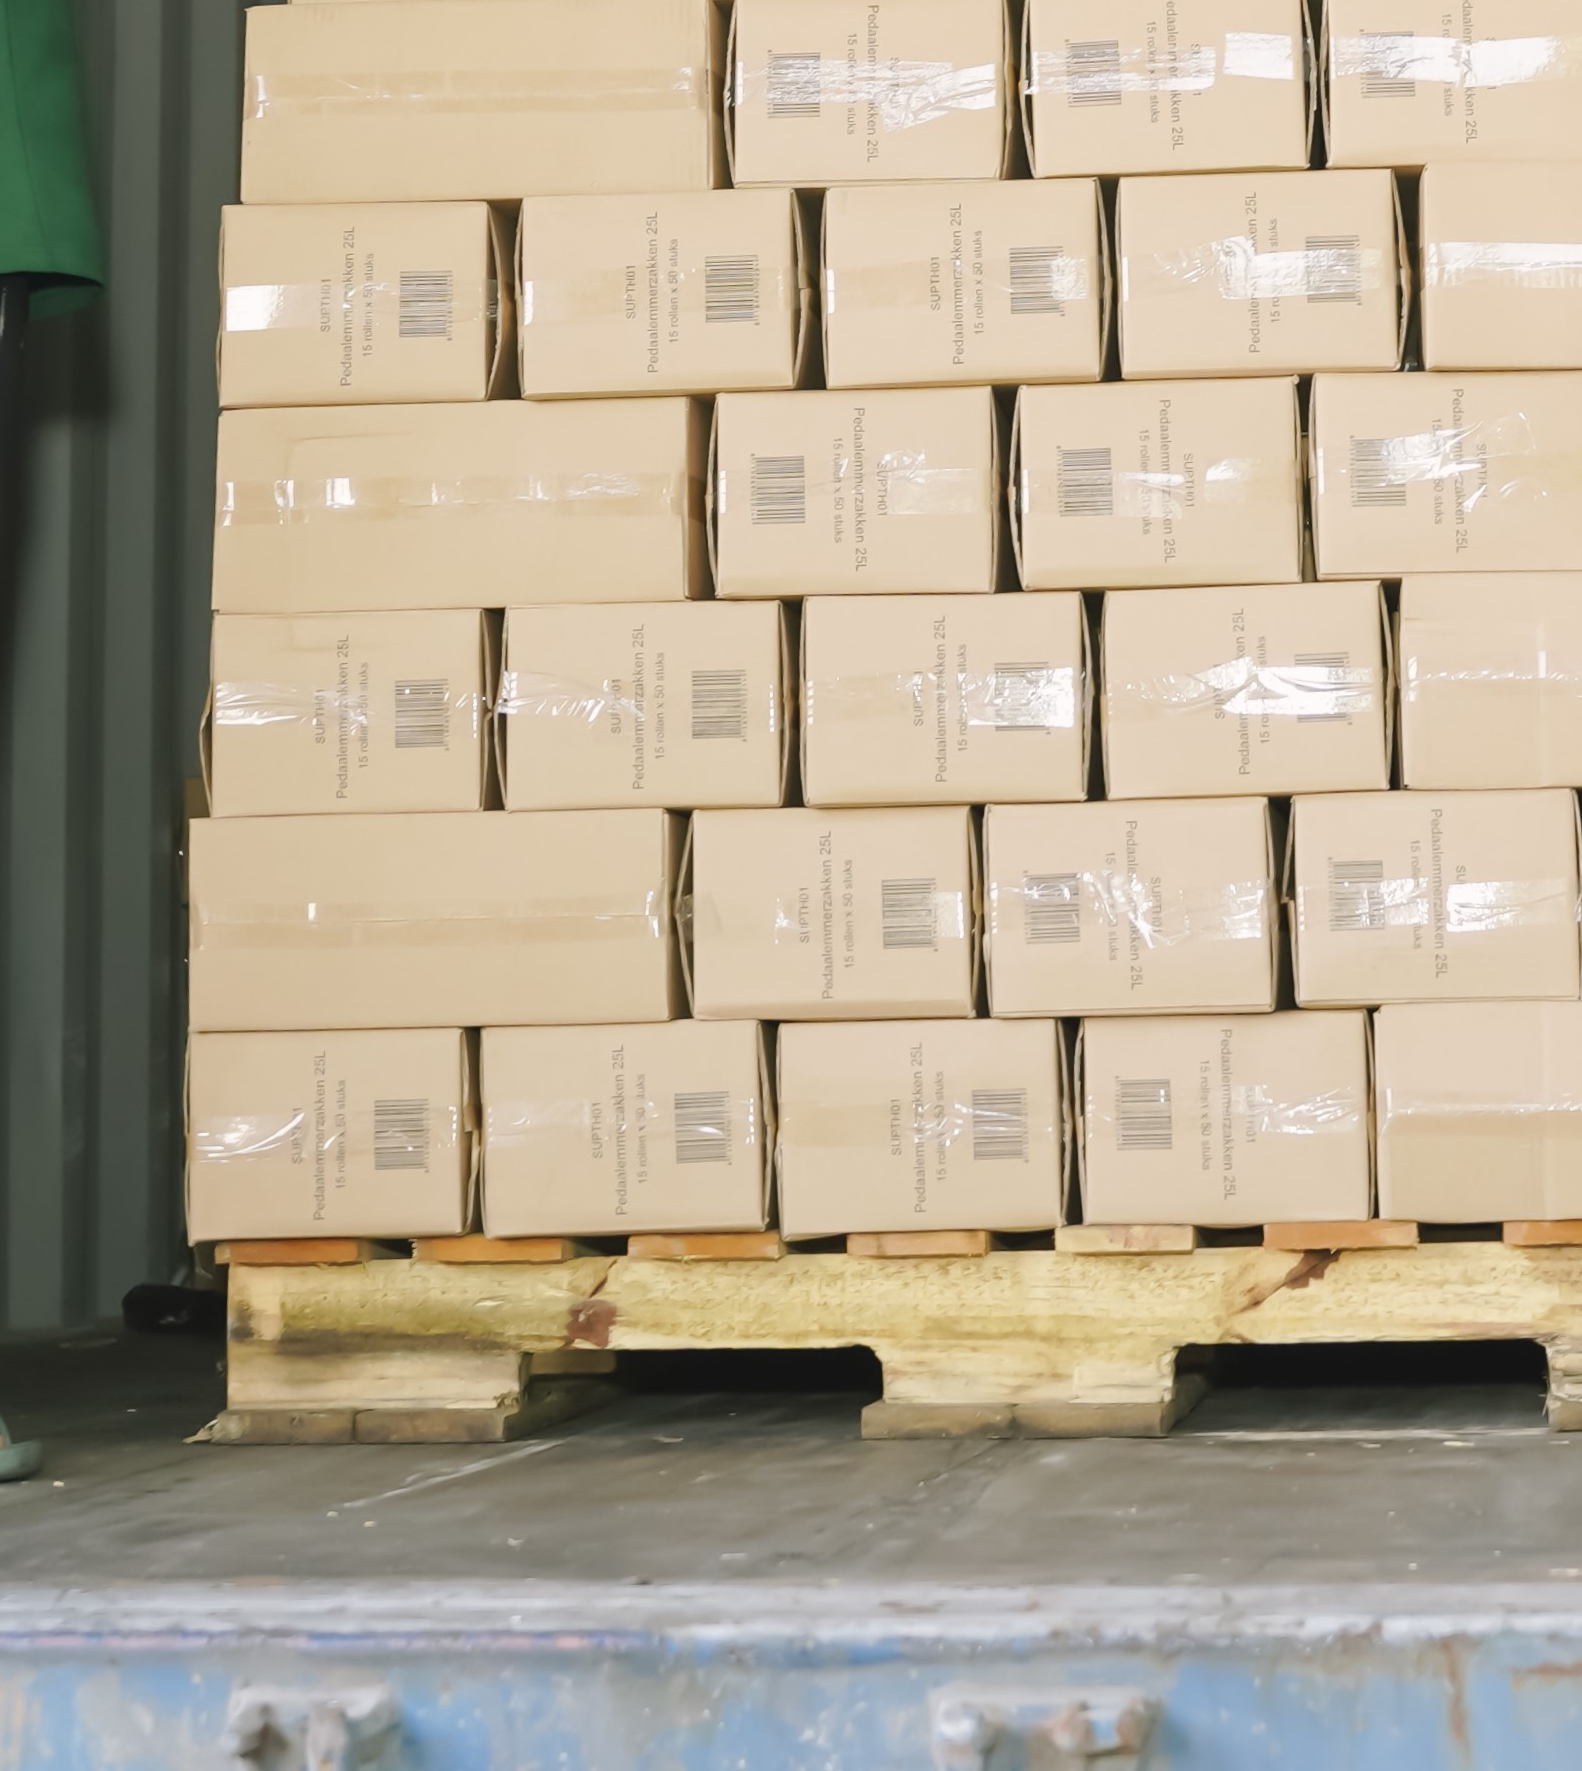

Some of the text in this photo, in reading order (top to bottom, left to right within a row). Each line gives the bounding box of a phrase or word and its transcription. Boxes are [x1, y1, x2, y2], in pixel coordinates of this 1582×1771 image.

[847, 33, 857, 136] 15 stuks
[1147, 21, 1160, 124] 15 stuks
[1442, 13, 1454, 117] 15 stuks
[866, 139, 878, 164] 25L
[1171, 127, 1183, 152] 25L
[1465, 120, 1477, 145] 25L
[950, 202, 962, 227] 25L
[1245, 190, 1257, 215] 25L
[342, 225, 355, 250] 25L
[625, 264, 636, 320] SUPTH01
[646, 210, 658, 373] Pedaalemmerzakken 25L
[668, 237, 678, 343] 15 rollen 50 stuks
[930, 255, 941, 311] SUPTH01
[973, 229, 984, 335] 15 rollen 50 stuks
[1268, 217, 1280, 323] 15 stuks
[320, 278, 332, 333] SUPTH01
[362, 252, 374, 357] 15 rollen stuks
[1139, 429, 1149, 443] 15
[833, 437, 844, 544] 15 50 stuks
[854, 407, 867, 573] Pedaalemmerzakken 25L
[1434, 496, 1444, 526] stuks
[1163, 540, 1176, 565] 25L
[1455, 529, 1468, 555] 25L
[337, 634, 349, 659] 25L
[633, 623, 644, 648] 25L
[934, 615, 946, 640] 25L
[1233, 607, 1245, 632] 25L
[359, 661, 369, 769] 15 stuks
[655, 651, 665, 759] 15 rollen 50 stuks
[1256, 635, 1270, 744] 15 stuks
[957, 738, 968, 752] 15
[1410, 839, 1421, 854] 15
[819, 829, 834, 999] Pedaalemmerzakken 25L
[843, 858, 854, 968] 15 rollen 50 stuks
[1105, 852, 1119, 962] 15 stuks
[1151, 876, 1162, 934] SUPTH01
[1130, 966, 1142, 992] 25L
[1434, 954, 1447, 980] 25L
[612, 1044, 624, 1070] 25L
[911, 1041, 923, 1067] 25L
[934, 1070, 946, 1182] 15 stuks
[1200, 1060, 1211, 1138] 15 50
[313, 1049, 326, 1221] Pedaalemmerzakken 25L
[591, 1101, 603, 1159] SUPTH01
[890, 1098, 902, 1156] SUPTH01
[335, 1175, 346, 1189] 15
[637, 1169, 648, 1184] 15
[1223, 1175, 1236, 1202] 25L
